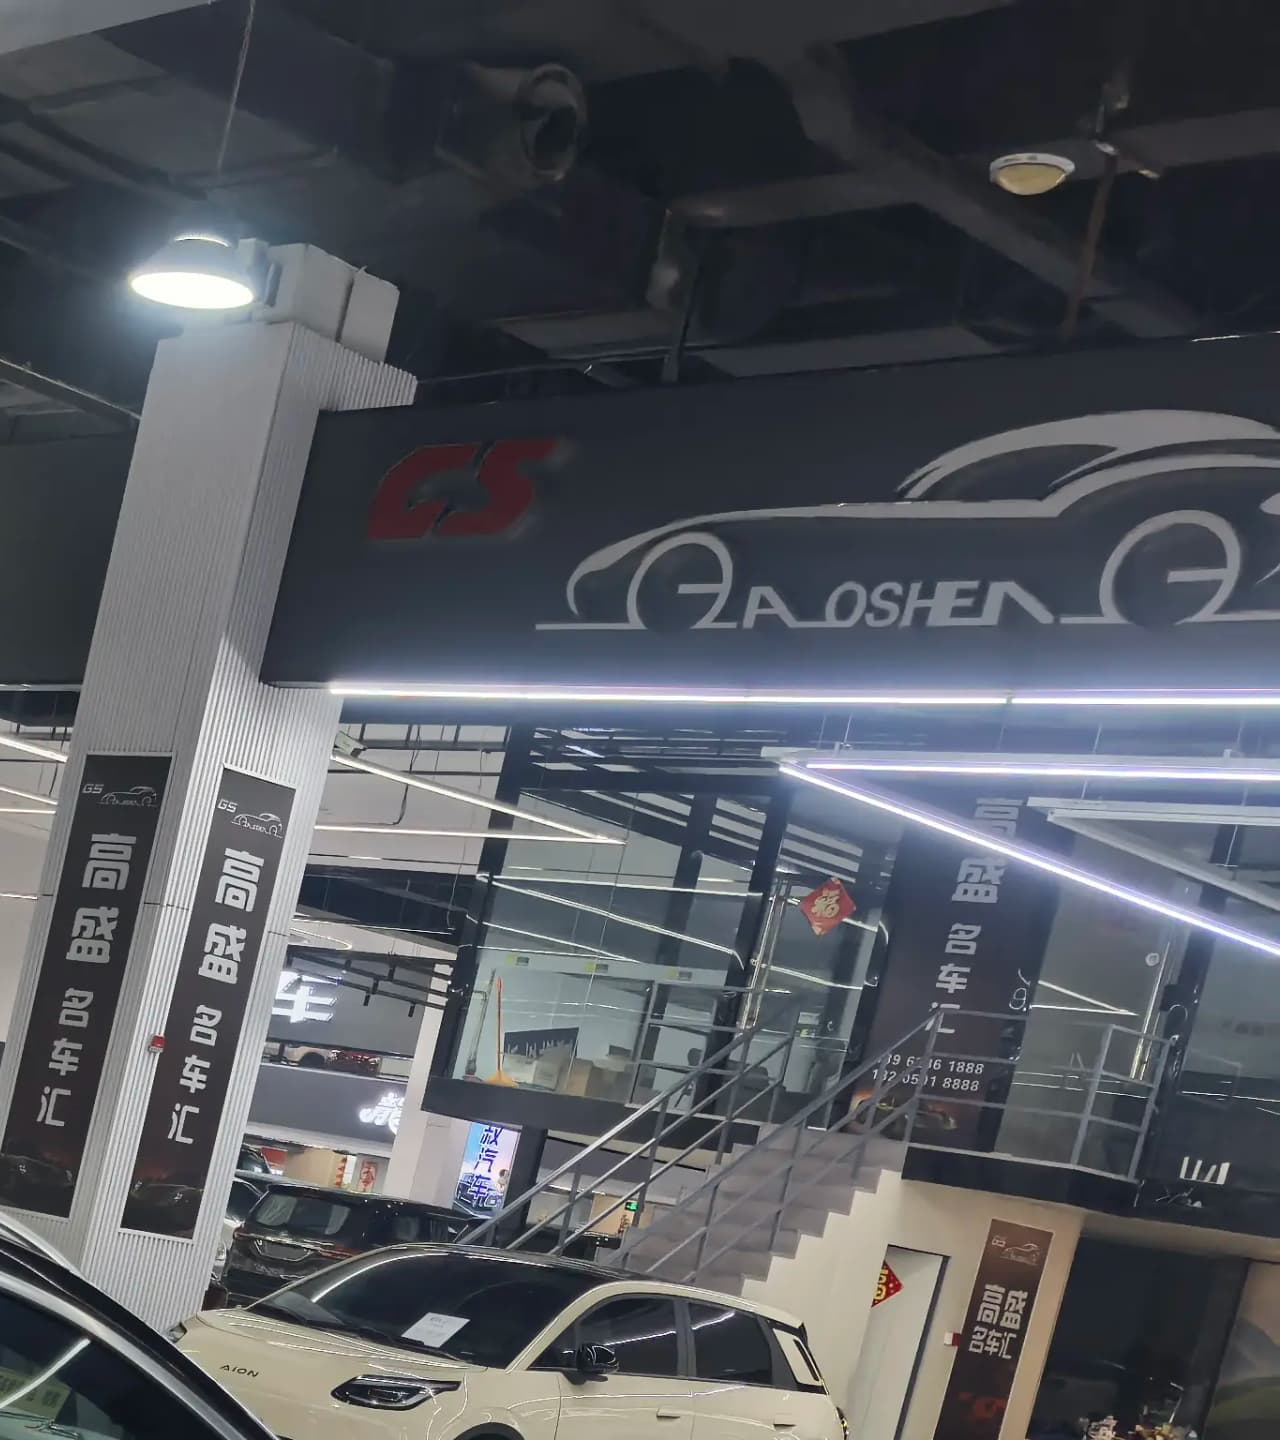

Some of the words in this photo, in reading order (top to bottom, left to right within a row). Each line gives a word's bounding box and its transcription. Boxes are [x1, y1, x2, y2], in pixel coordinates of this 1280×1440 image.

[368, 436, 561, 540] GS
[36, 833, 137, 1127] 高盛名车汇
[167, 848, 265, 1144] 高盛名车汇
[942, 1077, 979, 1092] 8888
[948, 1061, 984, 1075] 1888
[977, 1284, 1029, 1330] 高盛
[968, 1325, 1017, 1360] 名车汇
[220, 1364, 260, 1378] AION
